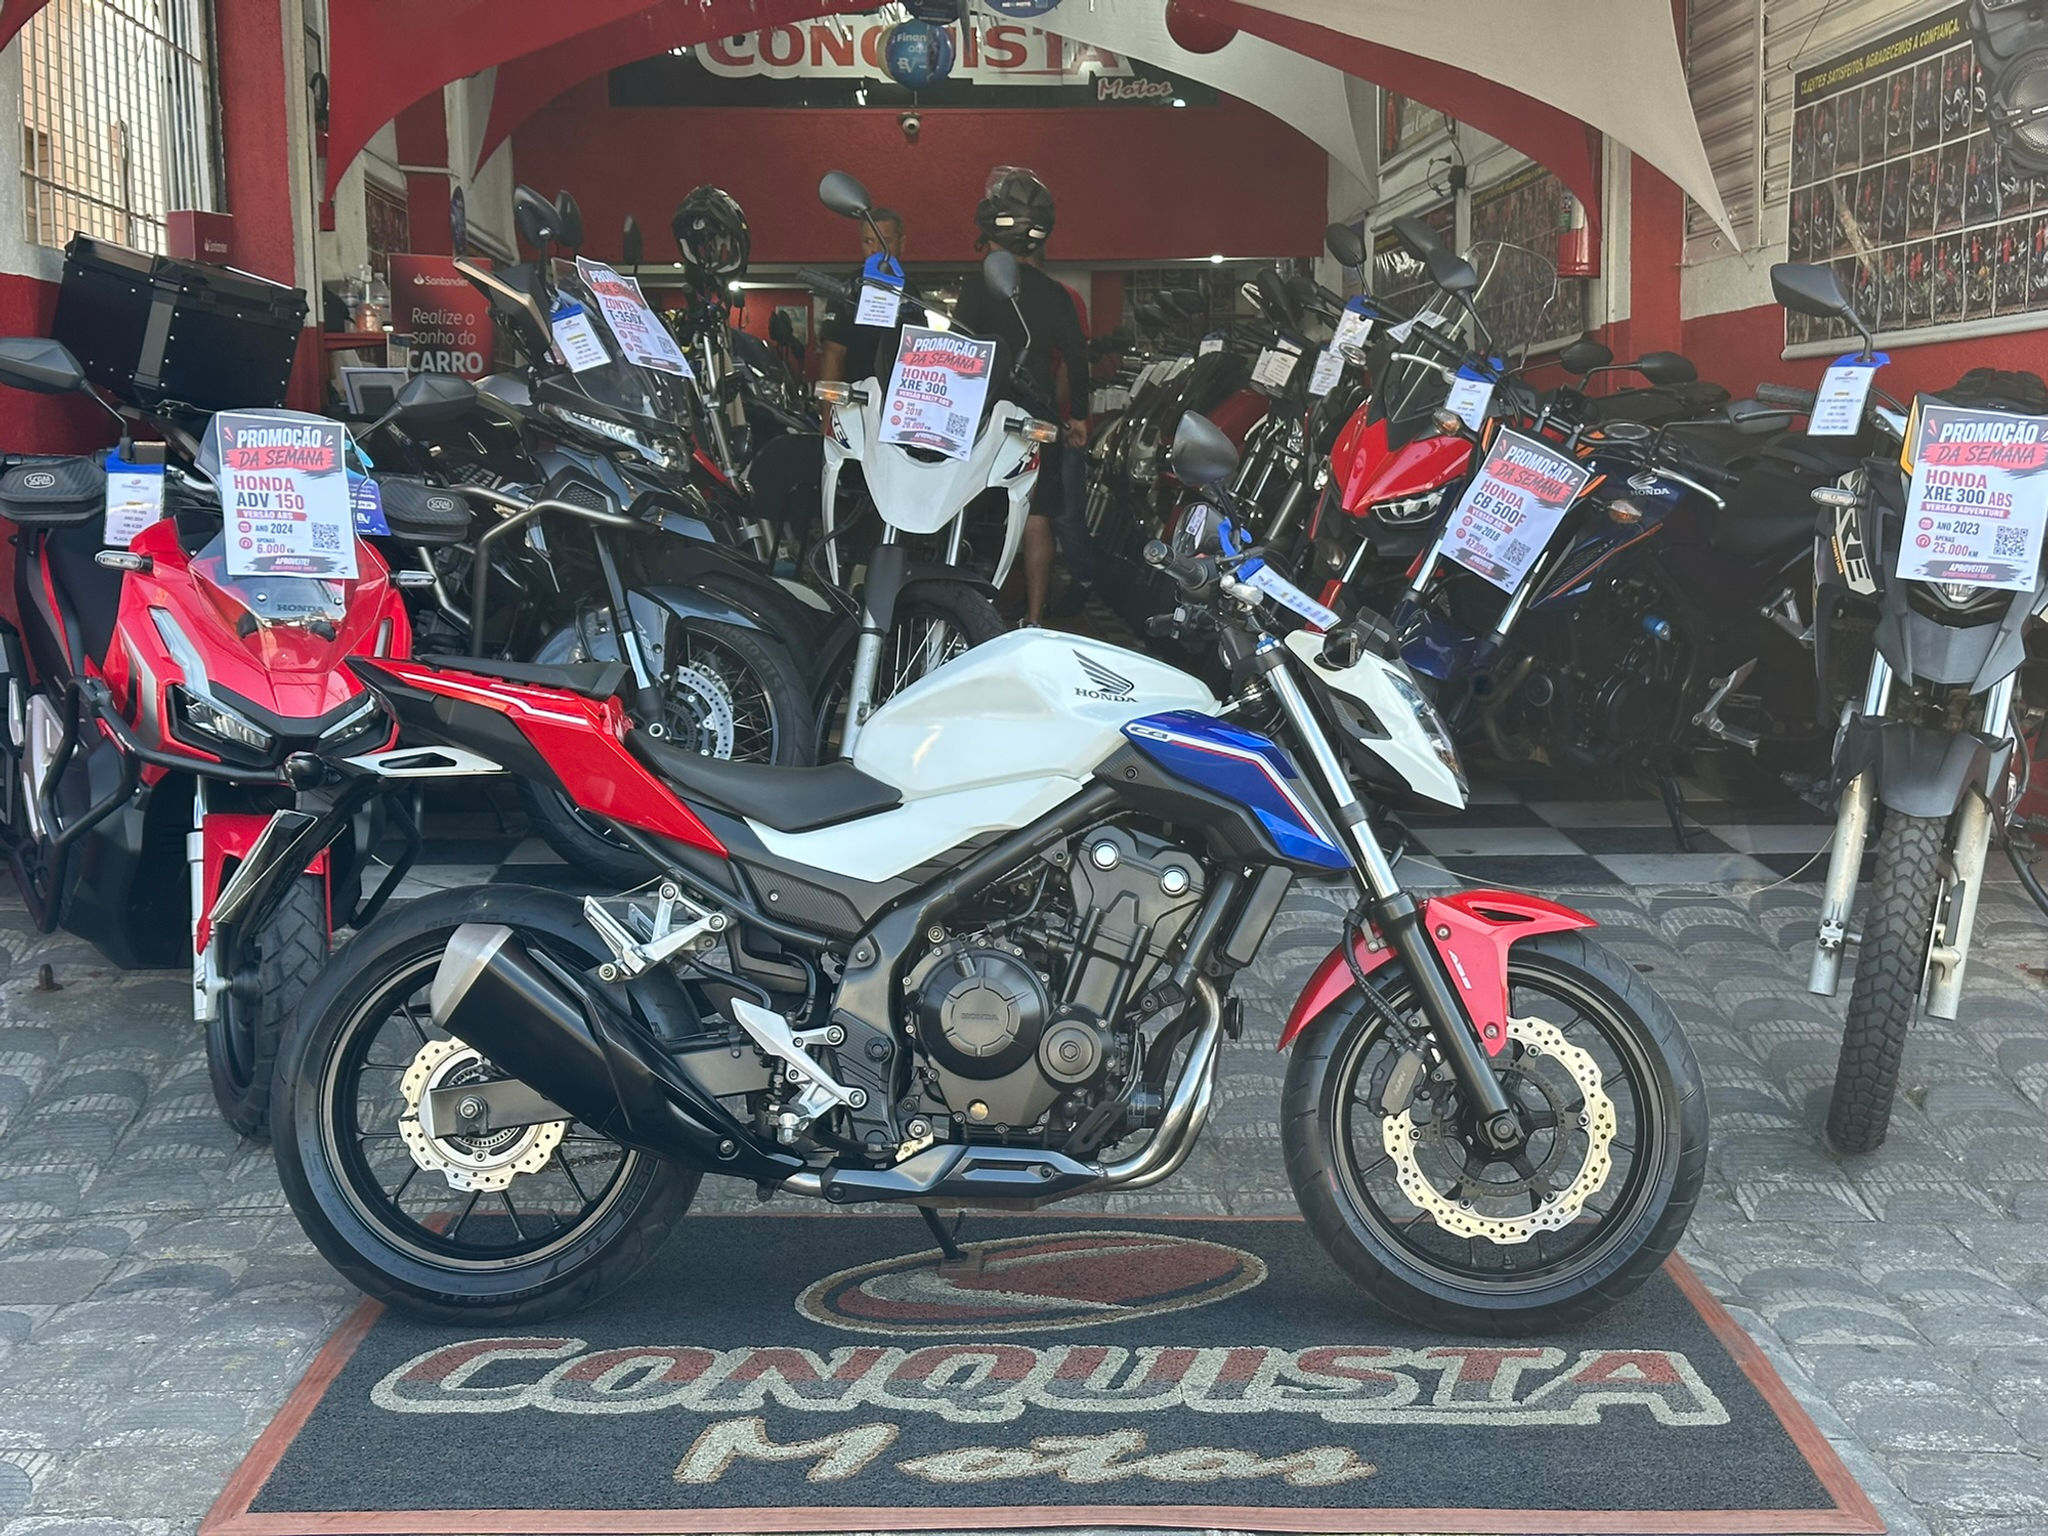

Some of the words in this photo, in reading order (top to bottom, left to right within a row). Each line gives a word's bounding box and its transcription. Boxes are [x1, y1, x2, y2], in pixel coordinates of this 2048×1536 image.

[703, 22, 1122, 72] CONISTA
[1800, 72, 1828, 95] CLIENTES
[1827, 57, 1865, 85] SATISFEITOS,
[1864, 37, 1913, 68] AGRADECEMOS
[1098, 78, 1173, 100] Motos
[425, 275, 469, 287] Santander
[412, 307, 463, 325] Realize
[465, 313, 475, 326] o
[411, 329, 455, 345] sonho
[457, 330, 477, 346] do
[912, 337, 978, 358] PROMOÇÃO
[408, 349, 484, 374] CARRO
[911, 353, 928, 366] DA
[930, 352, 976, 371] SEMANA
[901, 367, 948, 385] HONDA
[898, 378, 923, 391] XRE
[924, 382, 948, 397] 300
[236, 425, 323, 450] PROMOÇÃO
[1938, 421, 2039, 447] PROMOÇÃO
[239, 450, 261, 468] DA
[264, 449, 325, 467] SEMANA
[1503, 445, 1573, 483] PROMOÇÃO
[1935, 445, 1961, 463] DA
[1965, 445, 2036, 464] SEMANA
[233, 475, 295, 493] HONDA
[1495, 463, 1516, 481] DA
[1513, 468, 1563, 500] SEMANA
[1925, 468, 1988, 490] HONDA
[236, 492, 270, 509] ADV
[274, 494, 305, 510] 150
[1480, 479, 1525, 510] HONDA
[1630, 487, 1671, 496] HONDA
[1923, 485, 1954, 502] XRE
[1955, 489, 1985, 504] 300
[1988, 491, 2014, 508] ABS
[1472, 491, 1491, 510] CB
[1491, 501, 1528, 528] 500F
[1925, 502, 1958, 513] VERSÃO
[1957, 505, 2005, 518] ADVENTURE
[270, 523, 294, 535] 2024
[1481, 526, 1502, 542] 2018
[1936, 521, 1952, 531] ANO
[1952, 520, 1981, 535] 2023
[1932, 542, 1970, 557] 25.000
[276, 603, 325, 613] HONDA
[1073, 687, 1139, 703] HONDA
[370, 1336, 1731, 1426] CONQUISTA
[672, 1416, 1378, 1486] Motos
